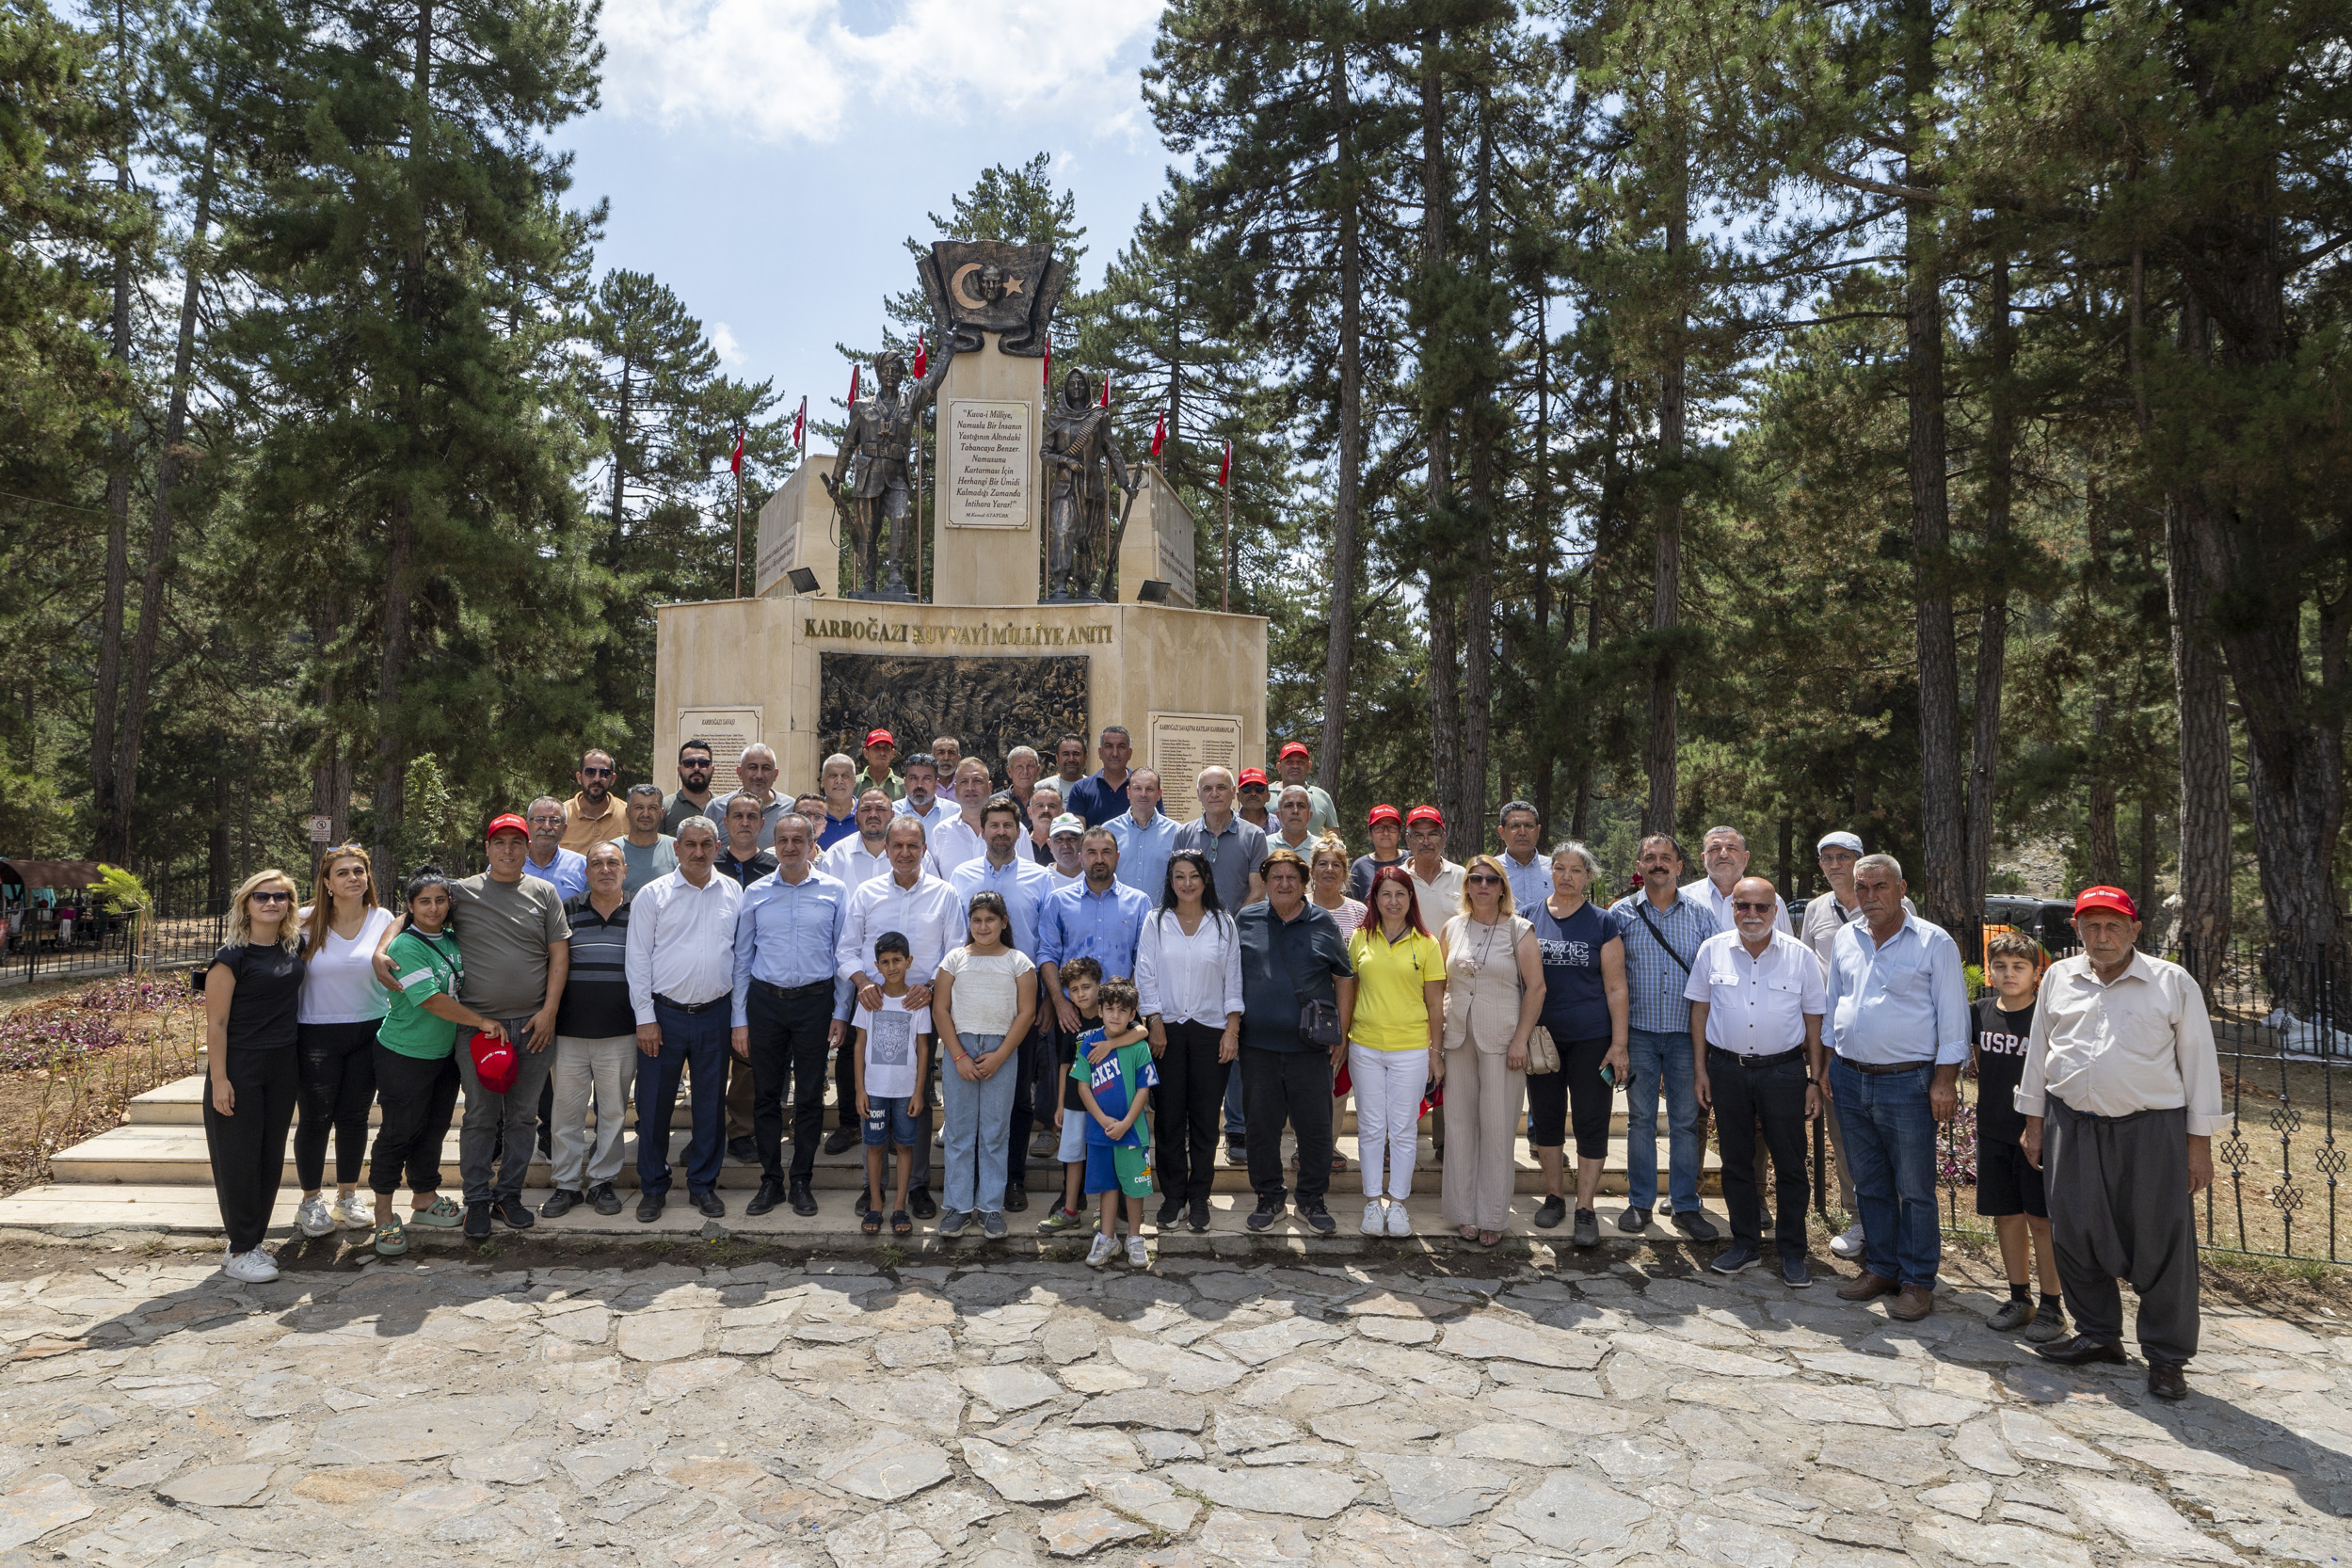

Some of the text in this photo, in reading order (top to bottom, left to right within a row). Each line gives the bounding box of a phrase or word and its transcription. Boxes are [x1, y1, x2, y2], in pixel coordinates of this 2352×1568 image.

[989, 410, 1013, 420] Milliye,
[957, 420, 1022, 430] Namuslu Bir İnsanın
[958, 431, 1021, 441] Yastığının Altındaki
[960, 442, 1020, 454] Tabancaya Benzer.
[971, 454, 1006, 463] Namusunu
[964, 465, 1014, 476] Kurtarması İçin
[957, 476, 988, 487] Herhangi
[989, 477, 1000, 486] Bir
[956, 488, 1021, 498] Kalmadığı Zamanda
[965, 498, 991, 508] İntihara
[805, 617, 1113, 646] KARBOĞAZI KUVVAYİ MİLLİYE ANITI
[869, 1110, 885, 1118] BORN
[869, 1121, 885, 1130] WILD
